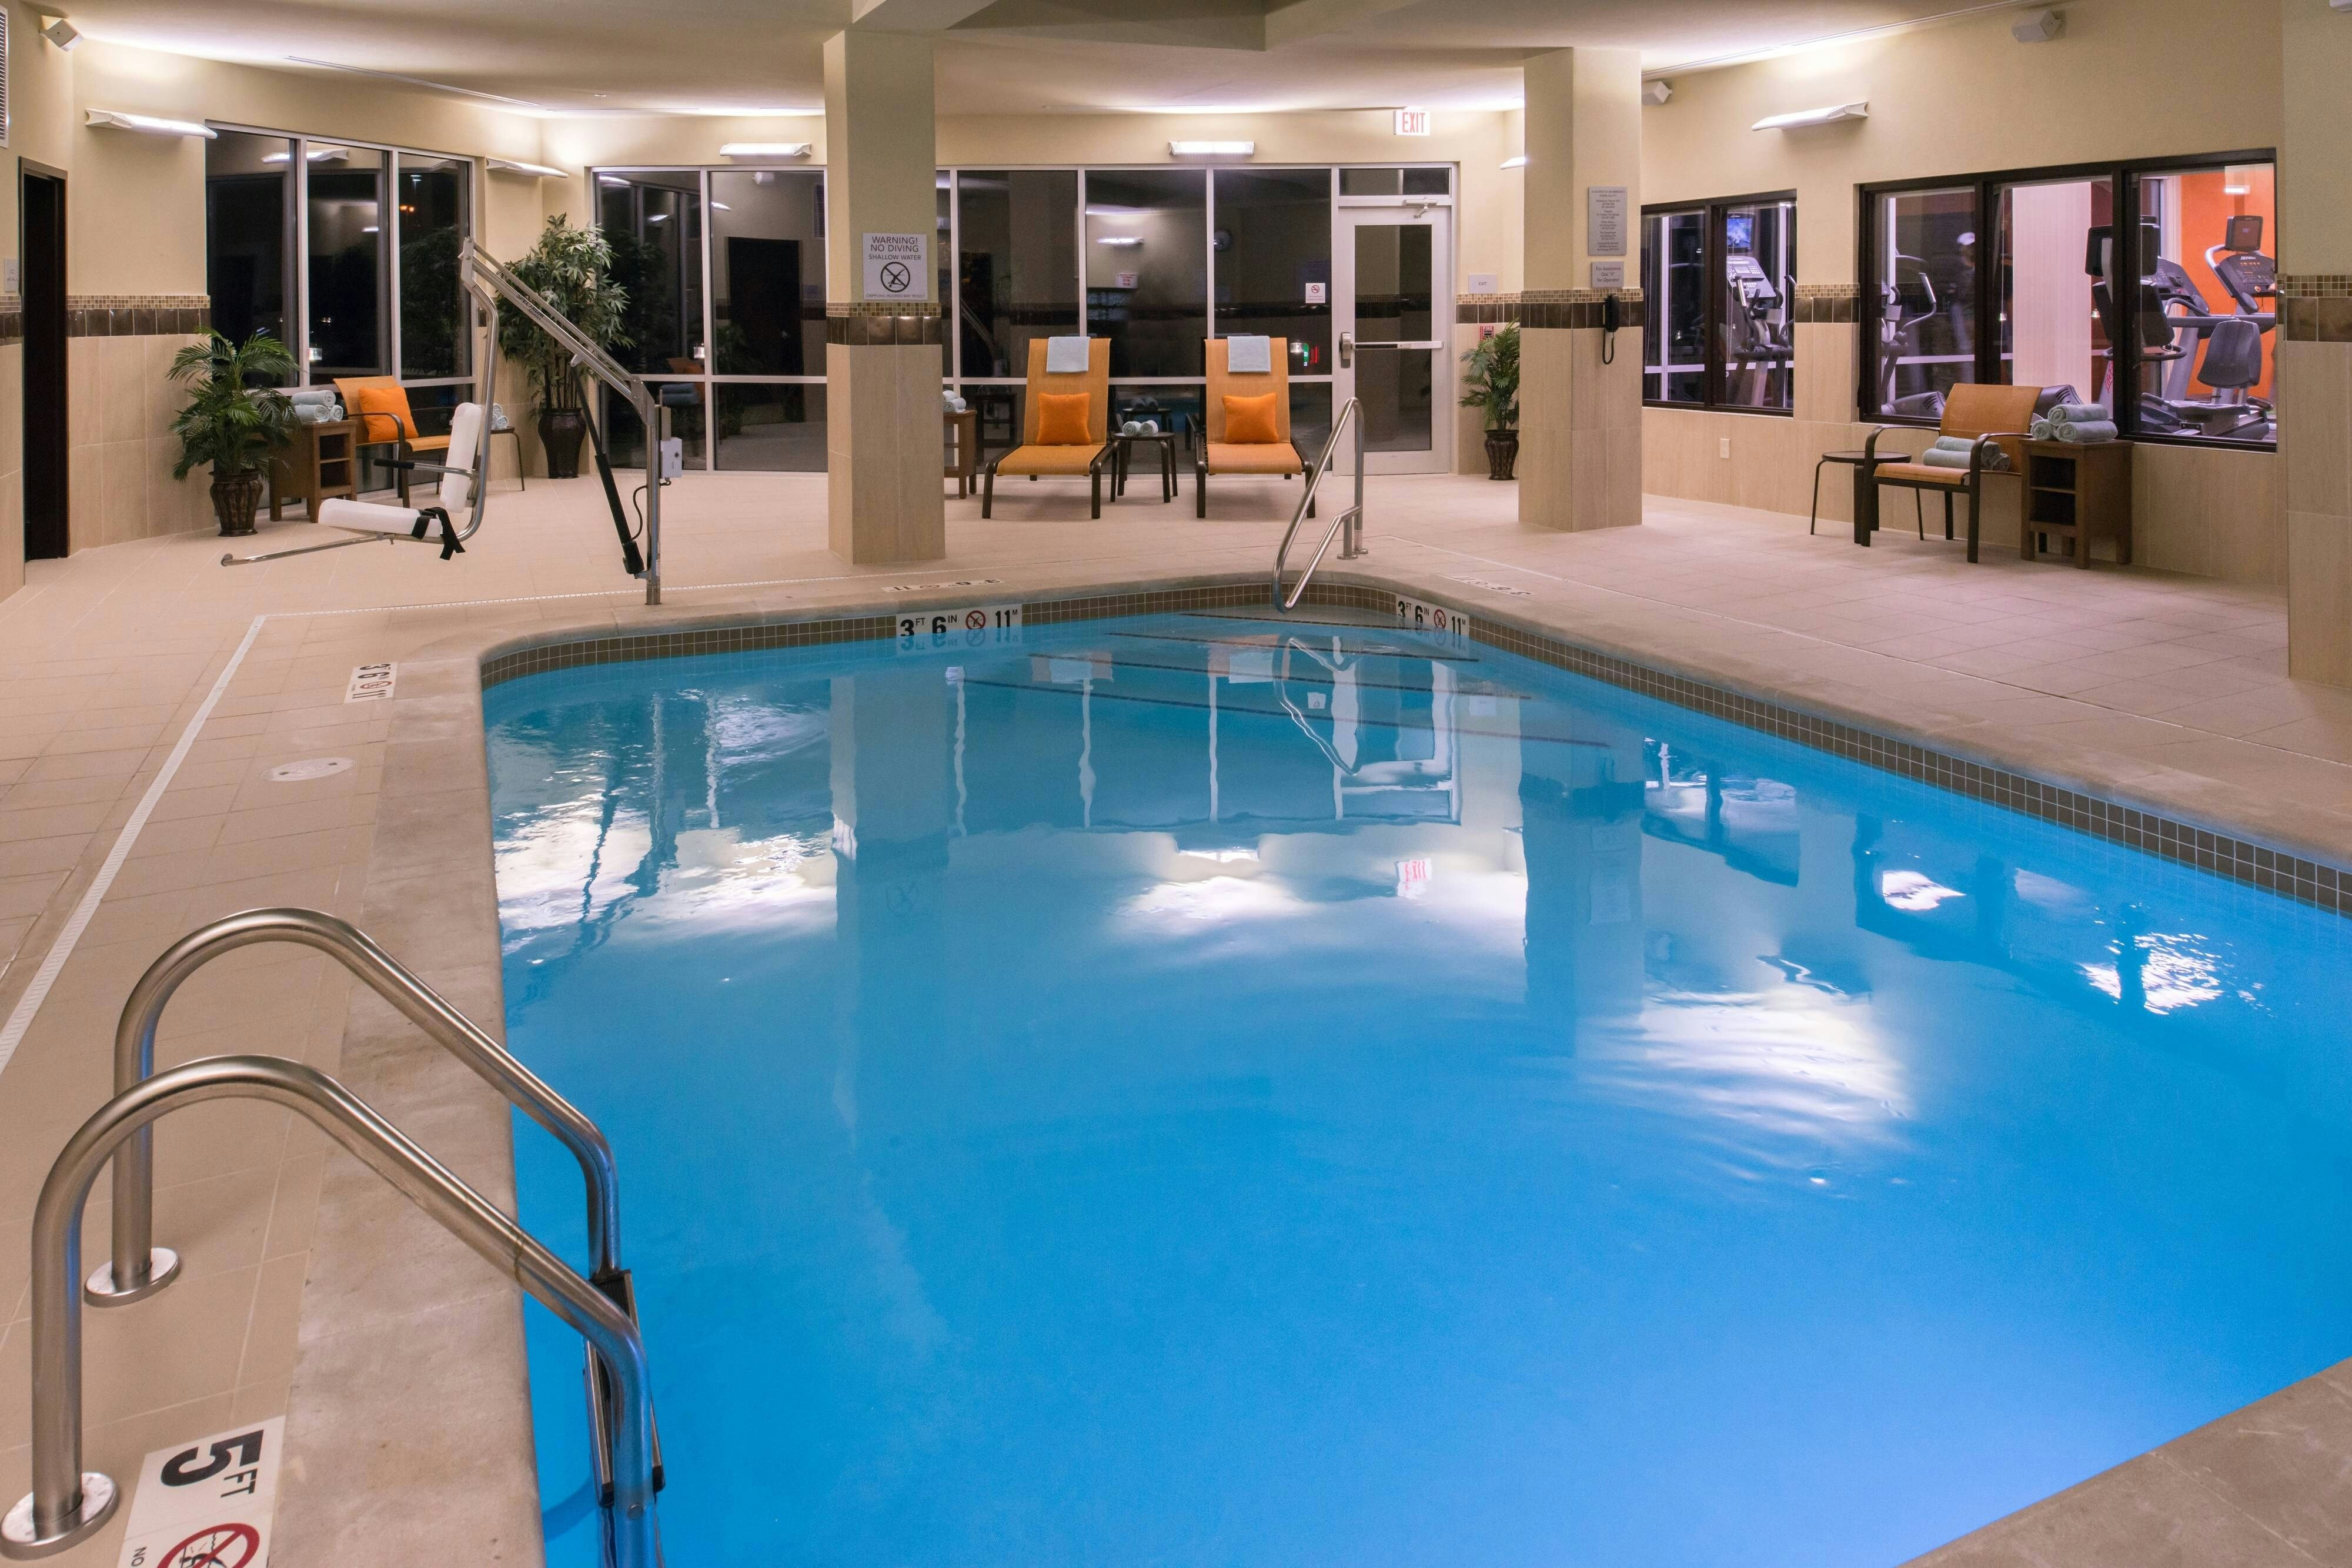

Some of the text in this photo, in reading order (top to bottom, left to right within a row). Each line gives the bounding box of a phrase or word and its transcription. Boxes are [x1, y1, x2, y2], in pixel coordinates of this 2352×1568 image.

[1402, 112, 1425, 133] EXIT
[870, 244, 919, 253] NO DIVING
[871, 236, 918, 245] WARNING!
[1398, 600, 1406, 617] 3
[1406, 602, 1412, 611] FT
[1415, 605, 1424, 623] 6
[1424, 607, 1429, 616] IN
[900, 619, 915, 637] 3
[916, 617, 926, 626] FT
[932, 616, 947, 634] 6
[948, 614, 957, 623] IN
[161, 1429, 264, 1498] 5 FT
[131, 1546, 147, 1567] NO
